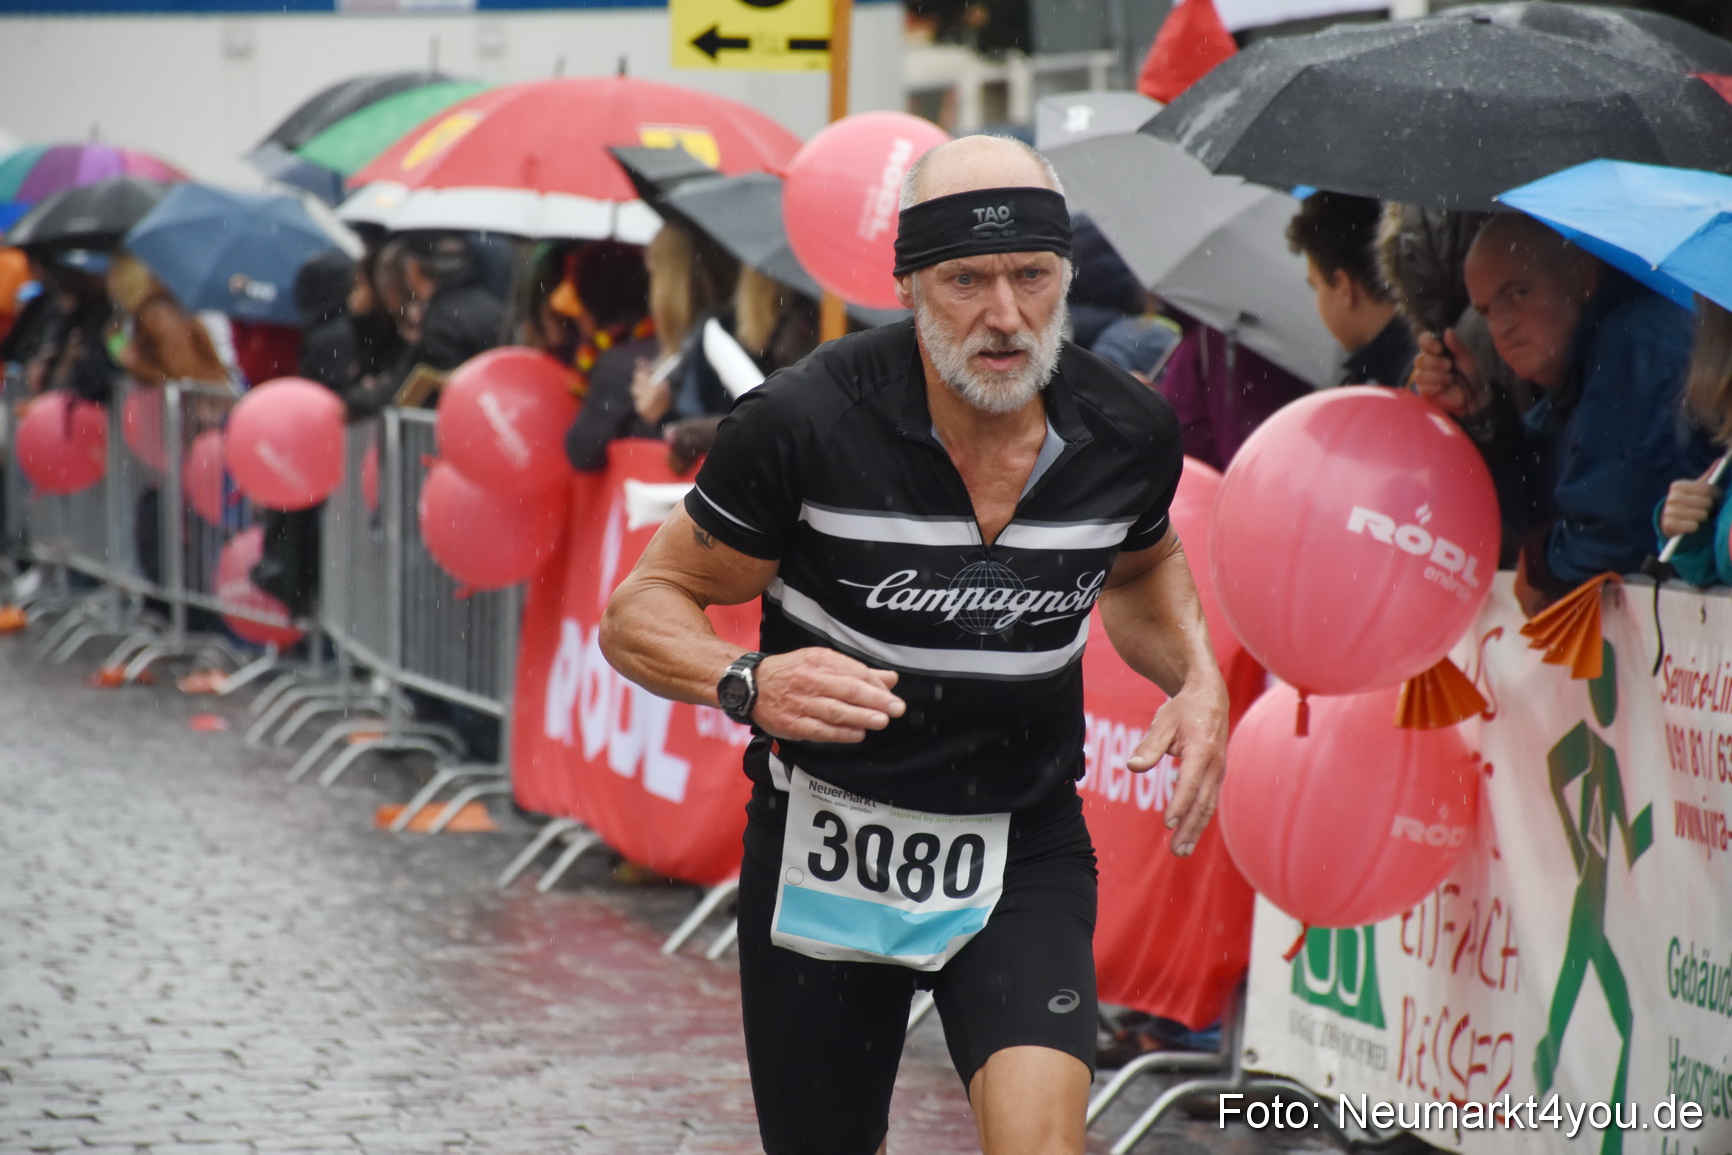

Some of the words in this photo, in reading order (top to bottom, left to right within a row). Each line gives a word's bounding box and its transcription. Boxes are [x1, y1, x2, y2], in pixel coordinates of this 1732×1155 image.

[973, 205, 1010, 222] TAO
[808, 780, 877, 808] NeuerMarkt
[888, 809, 922, 822] inspired
[923, 814, 934, 826] by
[936, 816, 958, 824] smart
[959, 815, 993, 825] concepts
[807, 809, 986, 904] 3080
